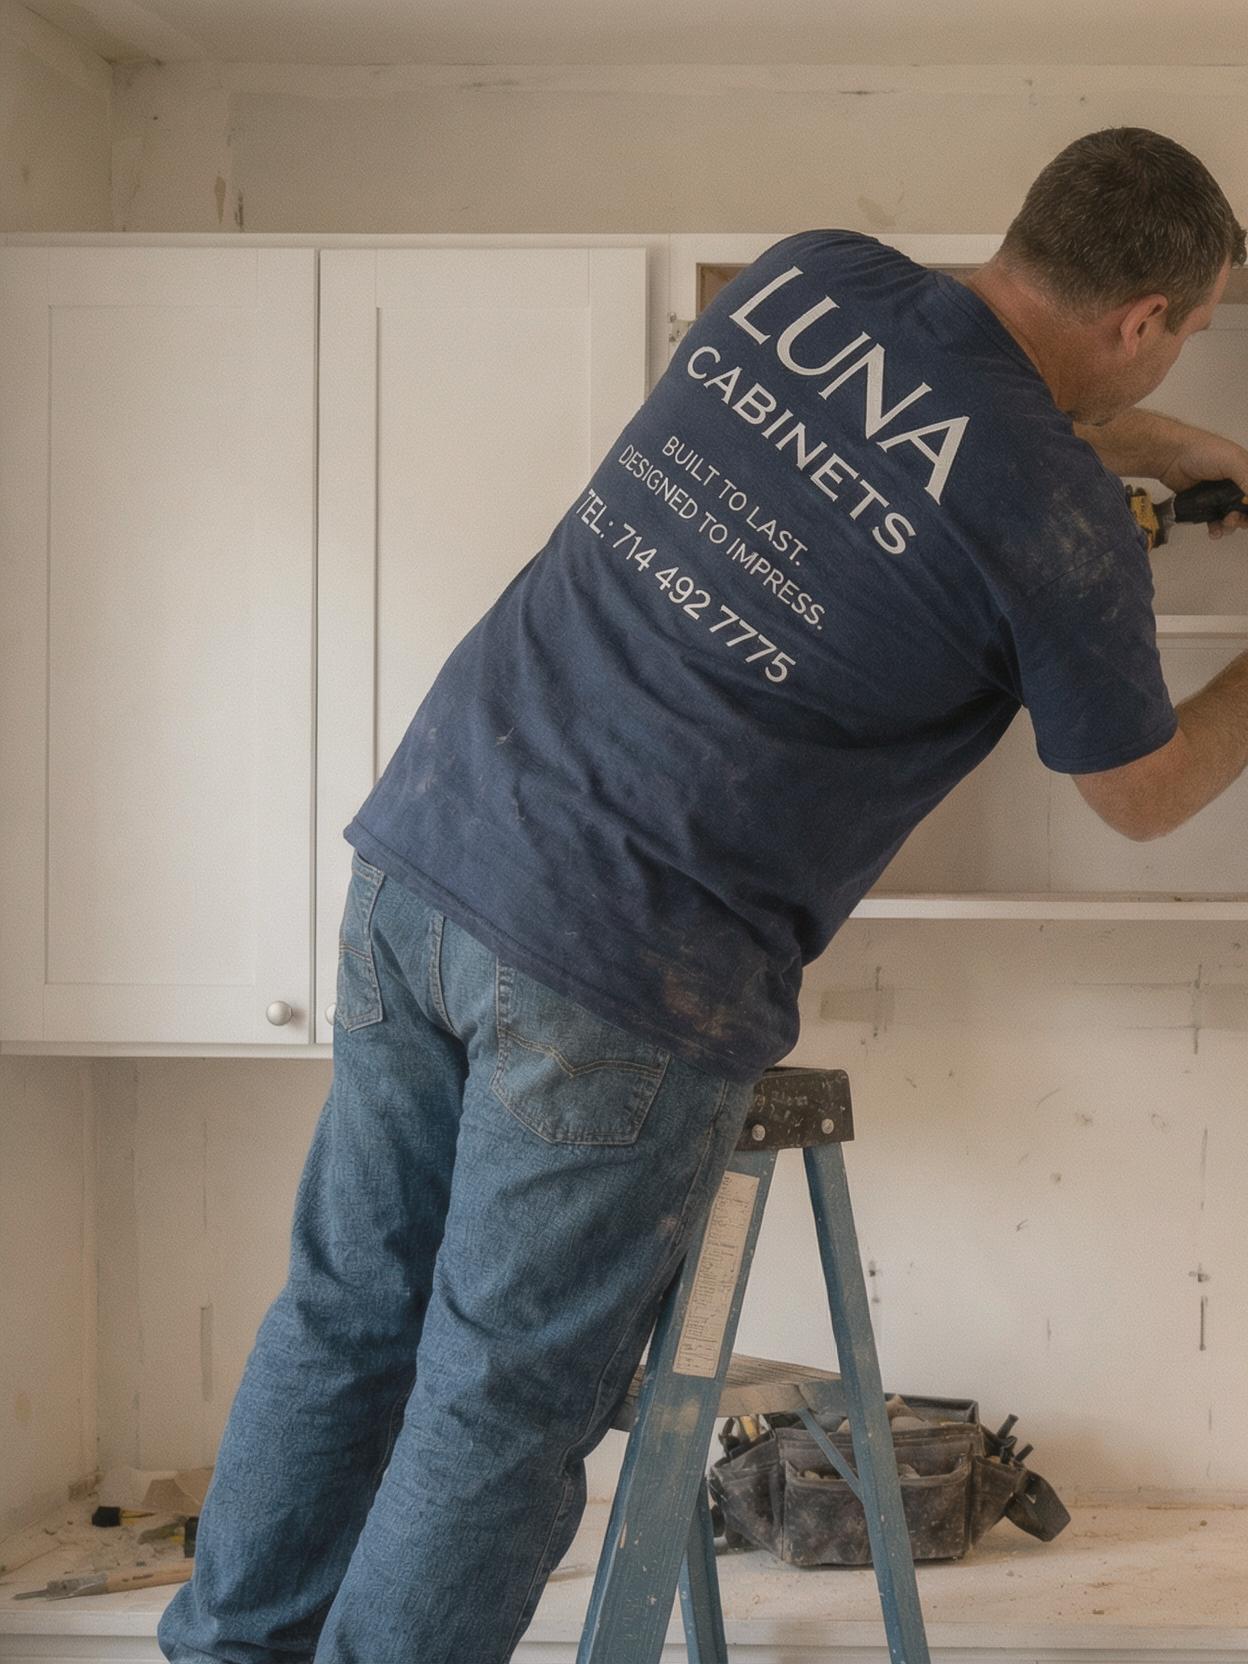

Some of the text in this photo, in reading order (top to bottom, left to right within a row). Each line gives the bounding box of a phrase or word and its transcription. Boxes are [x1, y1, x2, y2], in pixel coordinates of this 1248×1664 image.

[686, 345, 917, 555] CABINETS
[729, 265, 970, 505] LUNA
[618, 444, 826, 631] DESIGNED TO IMPRESS.
[661, 435, 809, 567] BUILT TO LAST.
[612, 522, 658, 572] 714
[654, 566, 713, 620] 492
[708, 605, 797, 683] 7775
